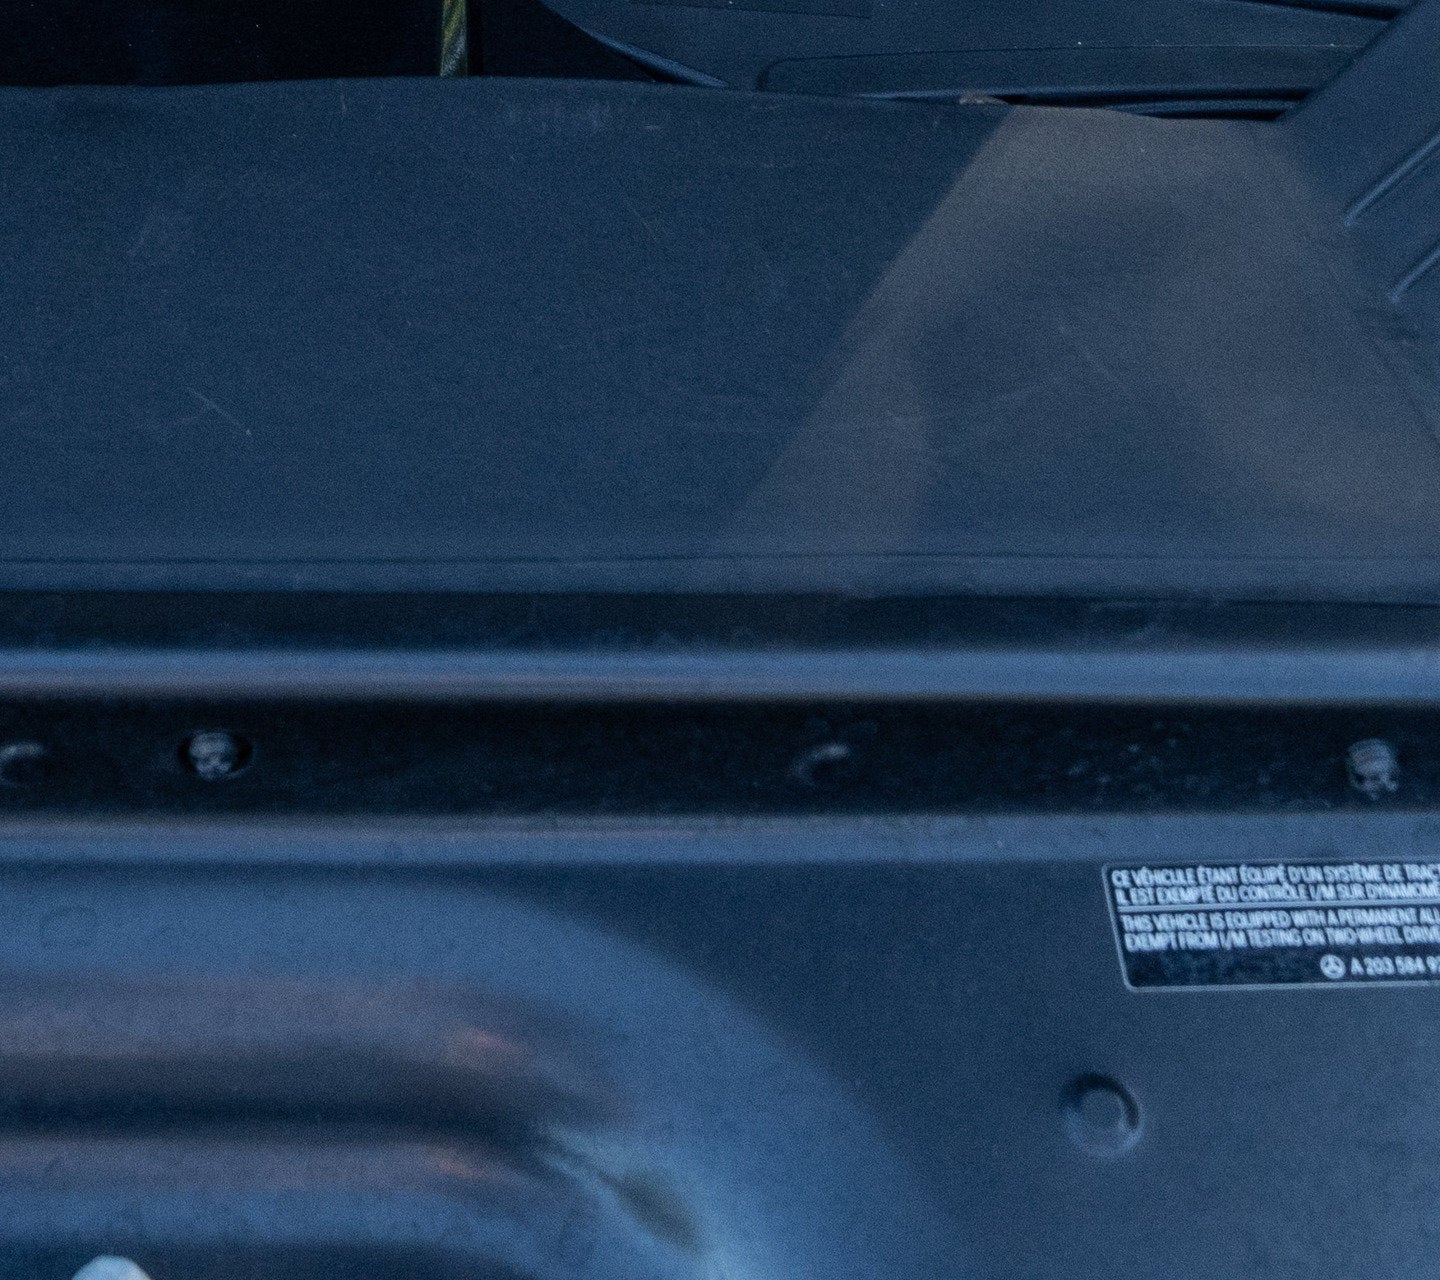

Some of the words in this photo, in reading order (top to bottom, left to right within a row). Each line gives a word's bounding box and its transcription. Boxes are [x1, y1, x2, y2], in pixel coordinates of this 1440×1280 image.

[1111, 868, 1131, 887] CE
[1132, 866, 1195, 887] VÉHICULE
[1197, 864, 1237, 885] ÉTANT
[1239, 863, 1285, 884] ÉQUIPÉ
[1288, 866, 1322, 883] D'UN
[1324, 863, 1382, 882] SYSTÈME
[1383, 864, 1403, 882] DE
[1116, 888, 1130, 906] IL
[1131, 886, 1155, 905] EST
[1157, 883, 1216, 904] EXEMPTÉ
[1217, 885, 1238, 902] DU
[1239, 882, 1309, 902] CONTRÔLE
[1336, 883, 1365, 900] SUR
[1121, 915, 1153, 932] THIS
[1153, 913, 1209, 932] VEHICLE
[1209, 913, 1225, 930] IS
[1226, 911, 1291, 930] EQUIPPED
[1292, 910, 1326, 928] WITH
[1326, 909, 1338, 926] A
[1338, 907, 1418, 926] PERMANENT
[1124, 932, 1178, 952] EXEMPT
[1179, 931, 1219, 950] FROM
[1248, 929, 1302, 947] TESTING
[1302, 928, 1325, 945] ON
[1351, 957, 1363, 975] A
[1365, 956, 1395, 976] 203
[1395, 956, 1425, 975] 584
